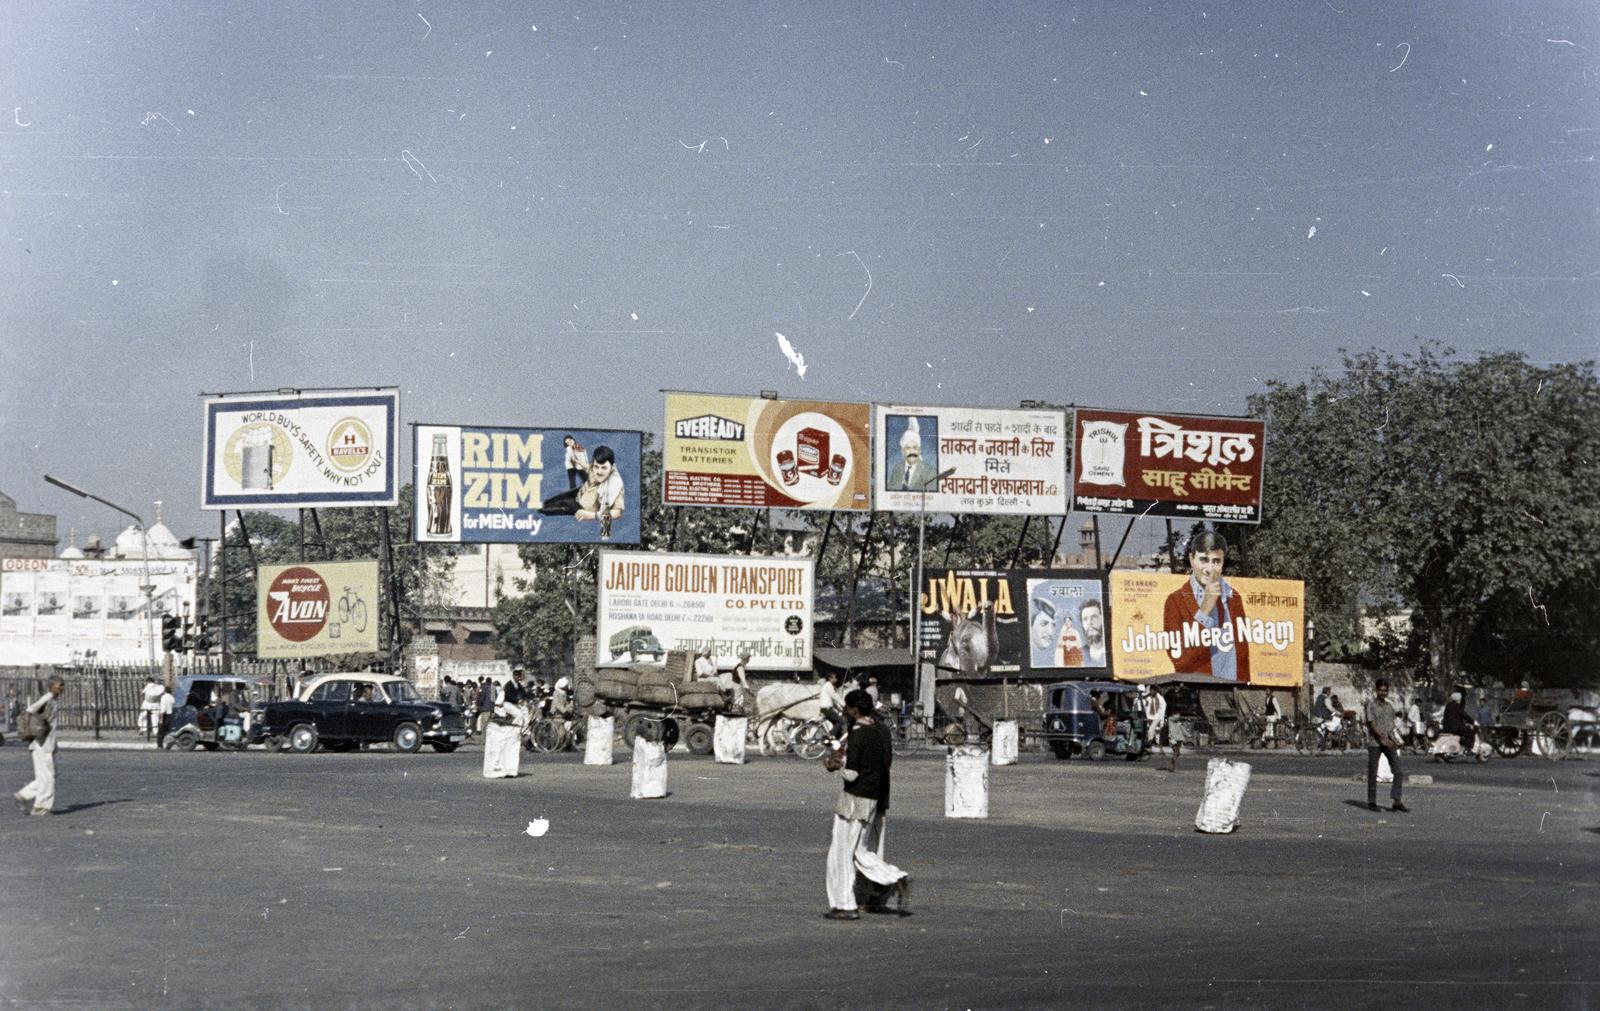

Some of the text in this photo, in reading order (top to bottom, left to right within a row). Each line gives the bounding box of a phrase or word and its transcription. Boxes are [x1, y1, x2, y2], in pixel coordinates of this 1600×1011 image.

[344, 434, 356, 445] H
[676, 416, 744, 440] EVEREADY
[241, 412, 276, 424] WORLD
[277, 413, 301, 438] BUYS
[322, 467, 343, 485] WHY
[343, 474, 364, 487] NOT
[461, 432, 544, 469] RIM
[680, 445, 737, 456] TRANSISTOR
[940, 437, 977, 456] ताकत
[984, 436, 1021, 457] जवानी
[1031, 436, 1055, 458] लिए
[1136, 416, 1256, 466] त्रिशूल
[681, 455, 734, 465] BATTERIES
[984, 458, 1011, 474] मिलें
[463, 472, 544, 509] ZIM
[1141, 469, 1189, 496] साहू
[463, 513, 543, 536] for MEN only
[6, 560, 48, 570] ODEON
[606, 561, 805, 596] JAIPUR GOLDEN TRANSPORT
[633, 599, 648, 607] GATE
[921, 570, 1015, 615] JWALA
[269, 591, 328, 624] AVON
[1121, 624, 1182, 659] Johny
[1236, 616, 1295, 651] Naam
